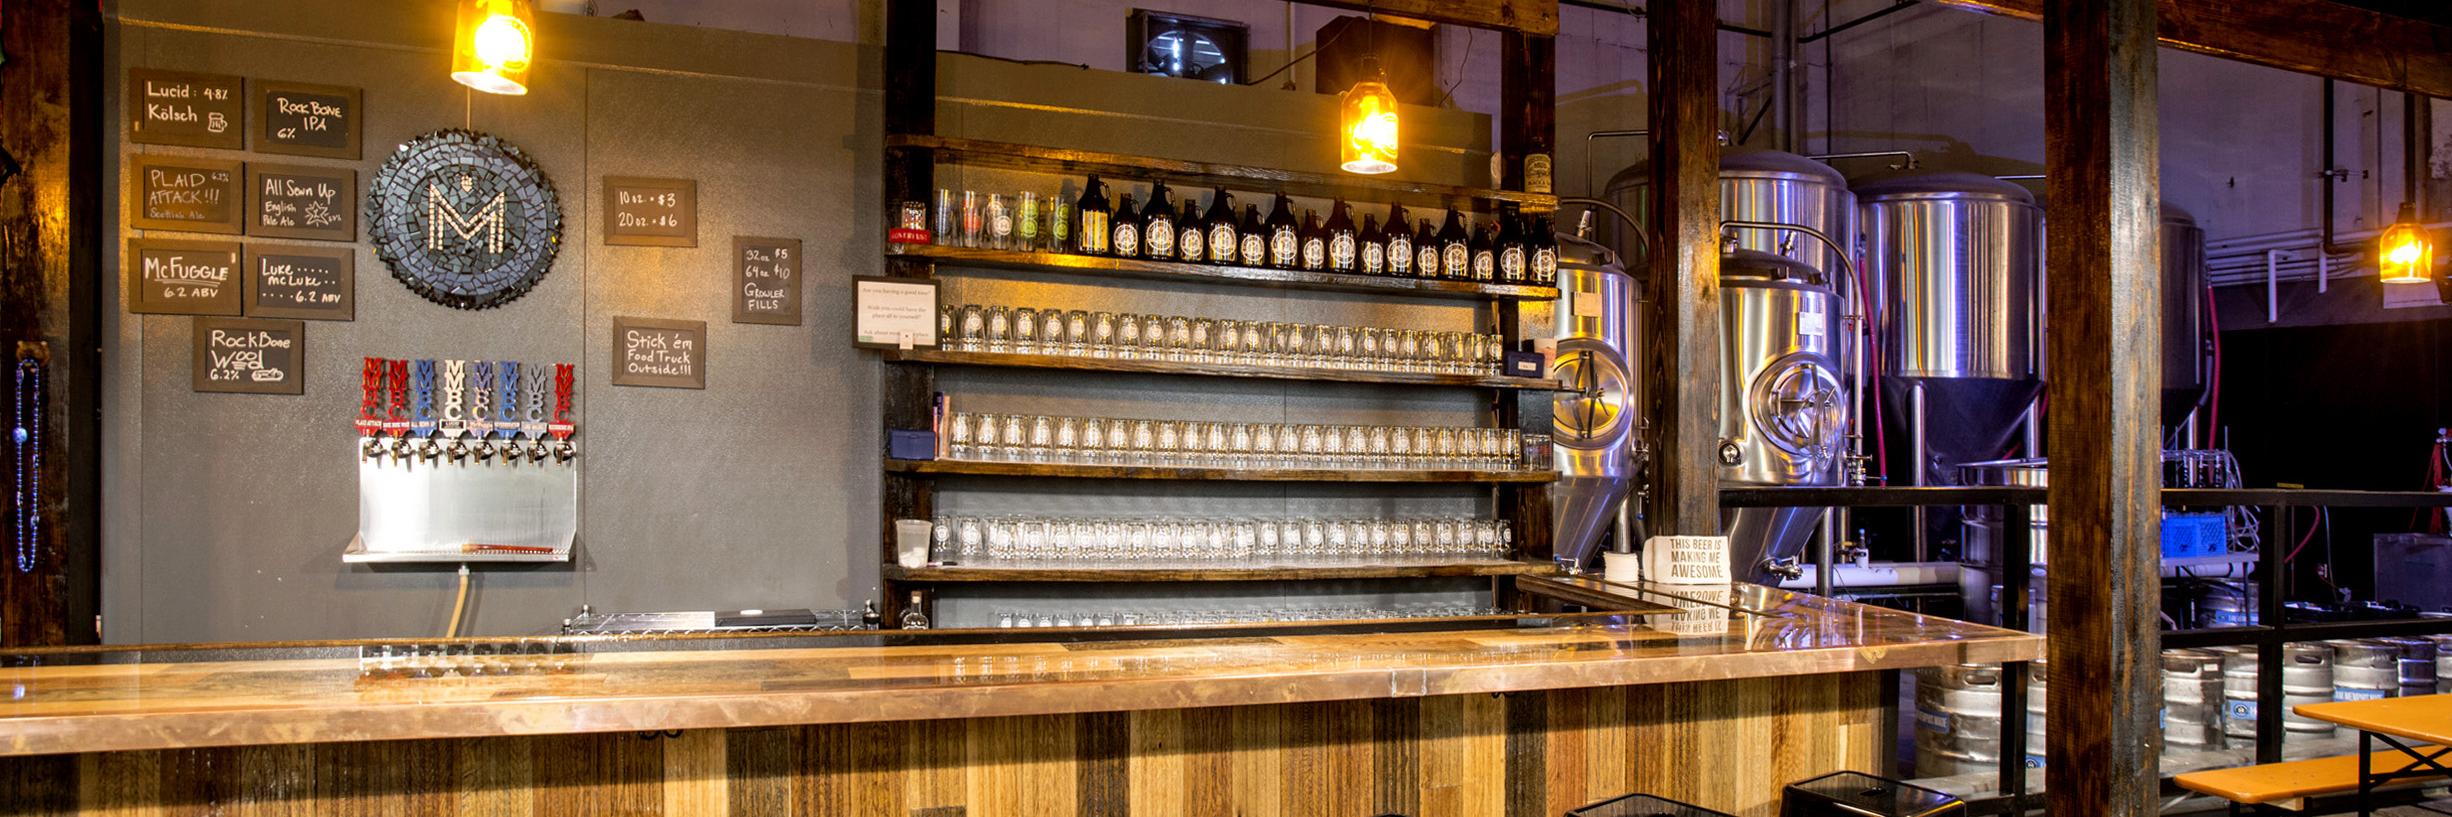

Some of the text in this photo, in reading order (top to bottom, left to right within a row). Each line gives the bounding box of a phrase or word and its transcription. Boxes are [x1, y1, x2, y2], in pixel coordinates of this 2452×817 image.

[148, 103, 198, 122] Kölsch
[303, 115, 327, 131] IPA
[277, 127, 296, 139] 6%
[150, 169, 206, 188] PLAID
[265, 178, 283, 196] All
[318, 183, 336, 205] Up
[265, 201, 297, 217] English
[263, 214, 295, 226] Pale Ale
[774, 263, 791, 280] $10
[192, 287, 219, 298] ABV
[627, 330, 667, 350] Stick
[627, 348, 691, 365] Food Truck
[210, 368, 240, 381] 6.2%
[1670, 538, 1722, 550] THIS BEER IS
[1671, 551, 1721, 563] MAKING ME
[1671, 564, 1724, 578] AWESOME
